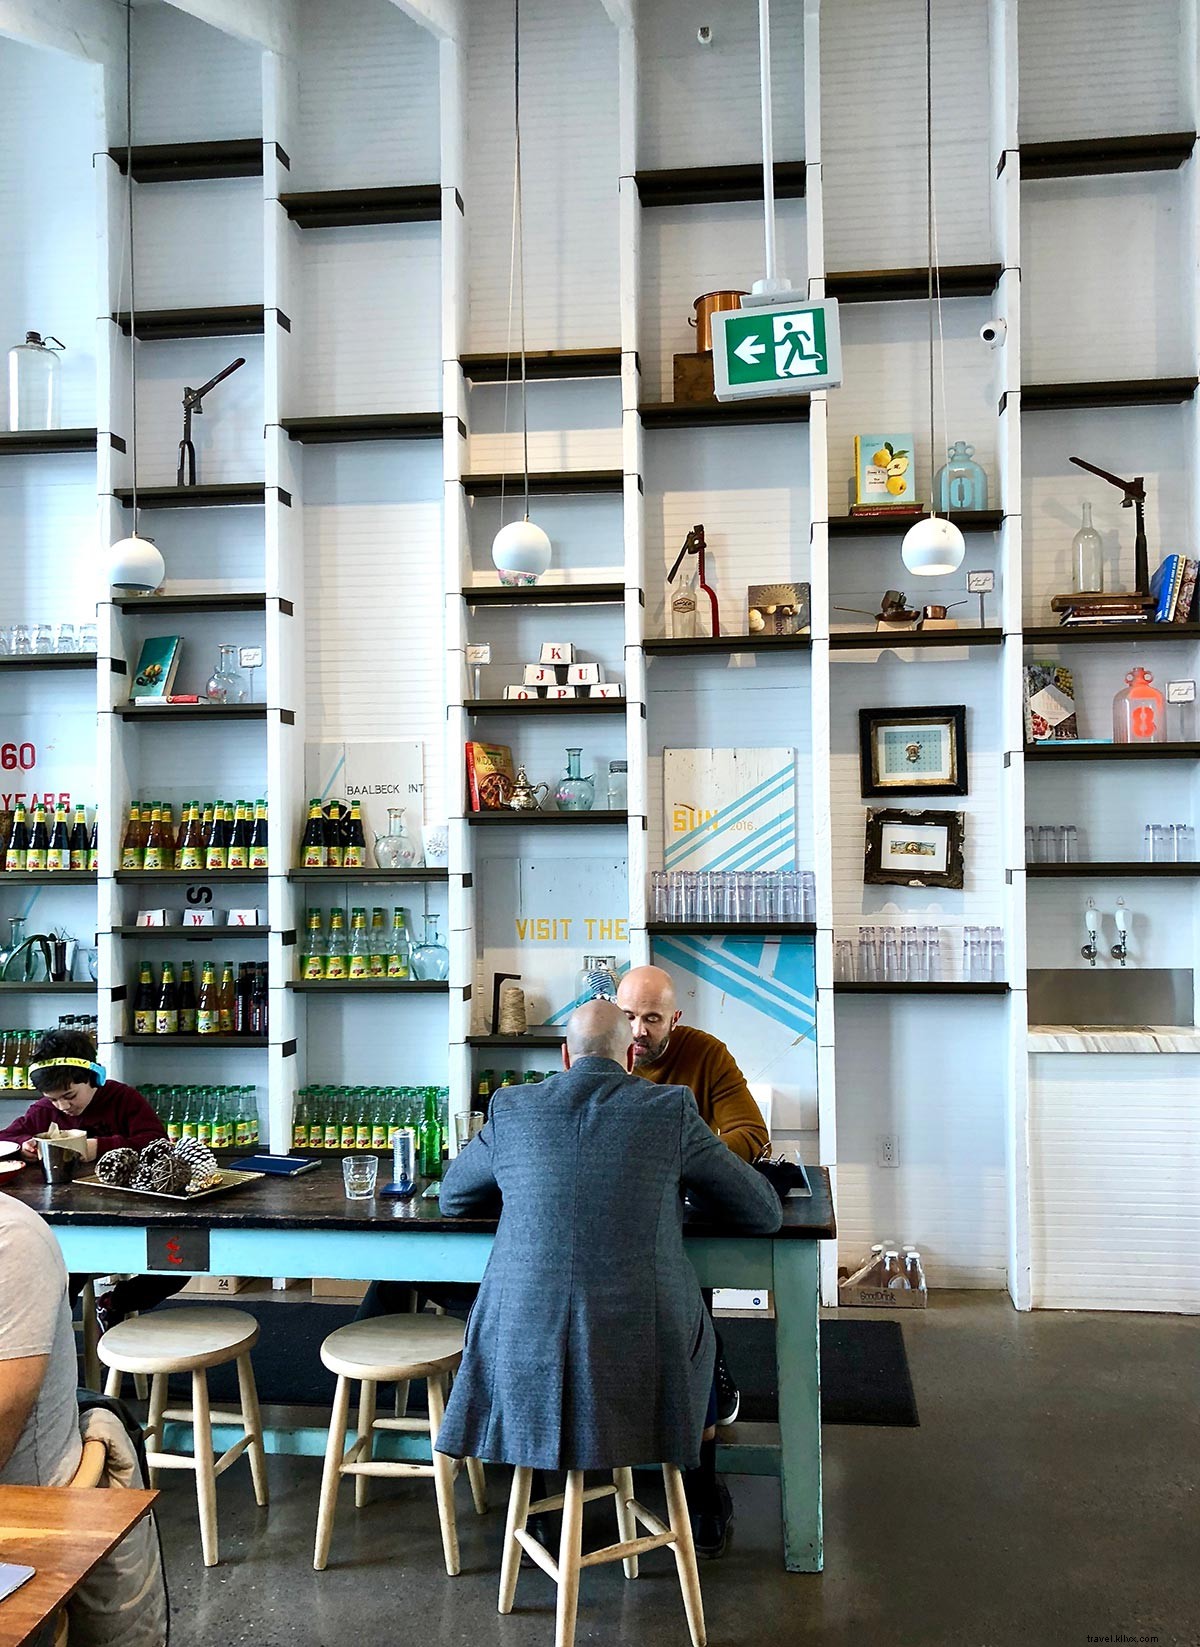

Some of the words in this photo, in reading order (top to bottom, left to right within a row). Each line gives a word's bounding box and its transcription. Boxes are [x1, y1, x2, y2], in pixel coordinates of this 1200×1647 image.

[551, 647, 562, 660] K
[536, 669, 545, 681] J
[578, 668, 588, 680] U
[557, 689, 567, 699] P
[1, 742, 36, 770] 60
[346, 784, 400, 796] BAALBECK
[408, 783, 424, 794] INT
[1, 793, 71, 814] YEARS
[673, 809, 719, 832] SUN
[192, 914, 205, 927] W
[237, 914, 247, 927] X
[515, 918, 573, 941] VISIT
[583, 918, 629, 941] THE
[218, 1279, 229, 1287] 24
